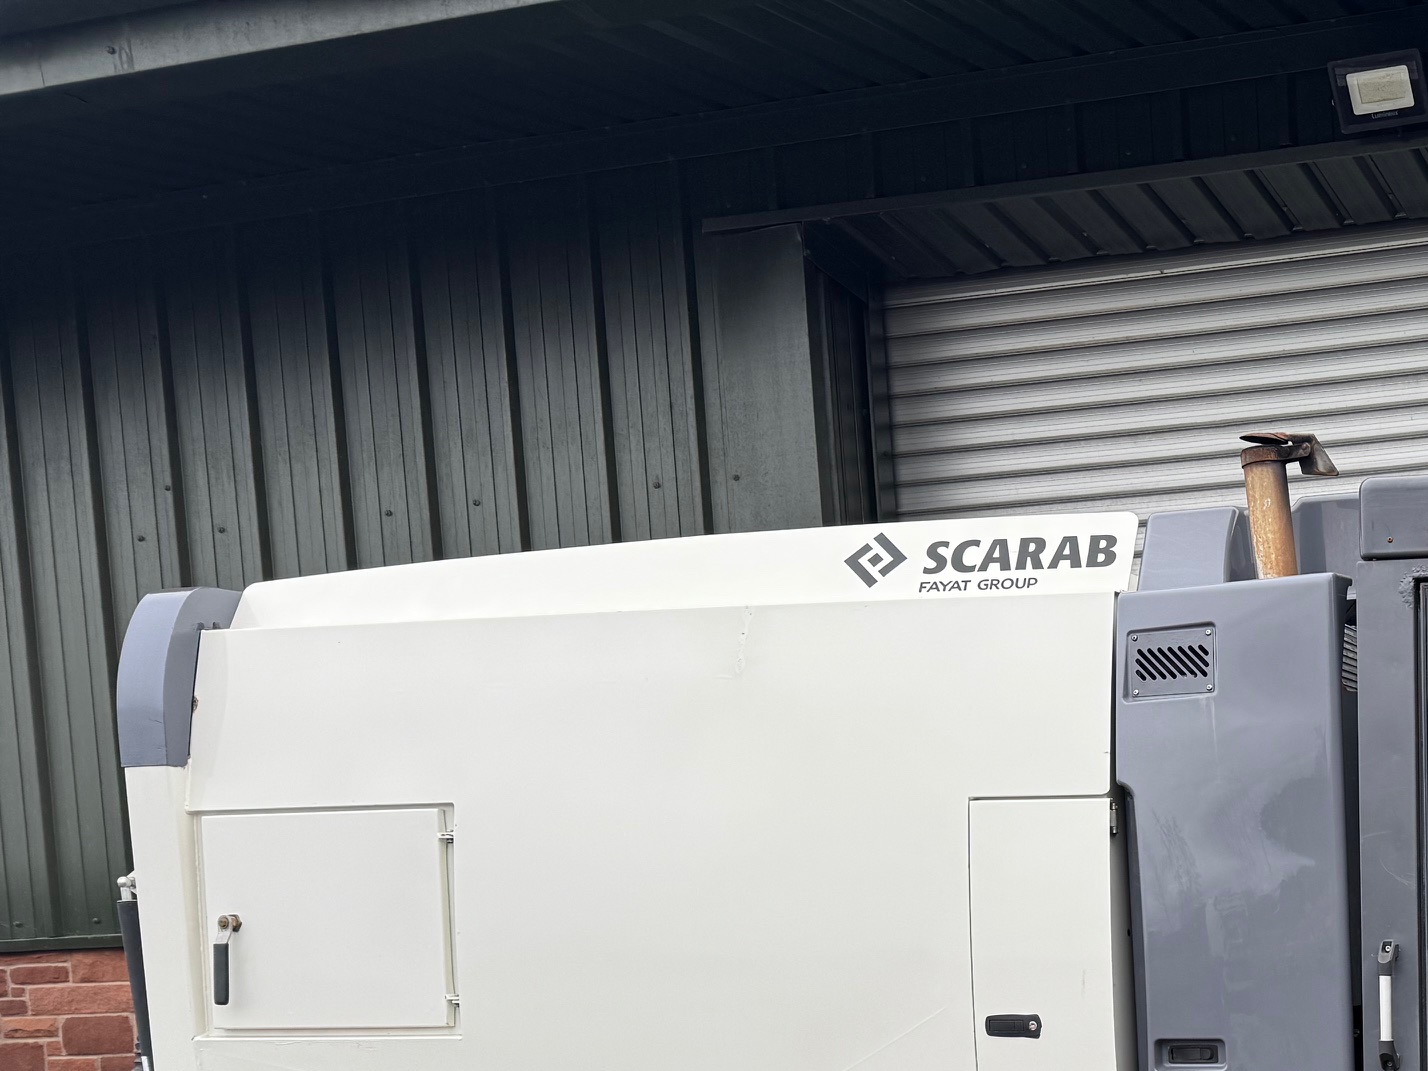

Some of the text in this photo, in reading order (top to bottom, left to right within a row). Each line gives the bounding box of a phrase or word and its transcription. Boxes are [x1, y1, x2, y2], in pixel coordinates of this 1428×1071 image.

[922, 534, 1118, 575] SCARAB
[918, 577, 1038, 593] FAYAT GROUP
